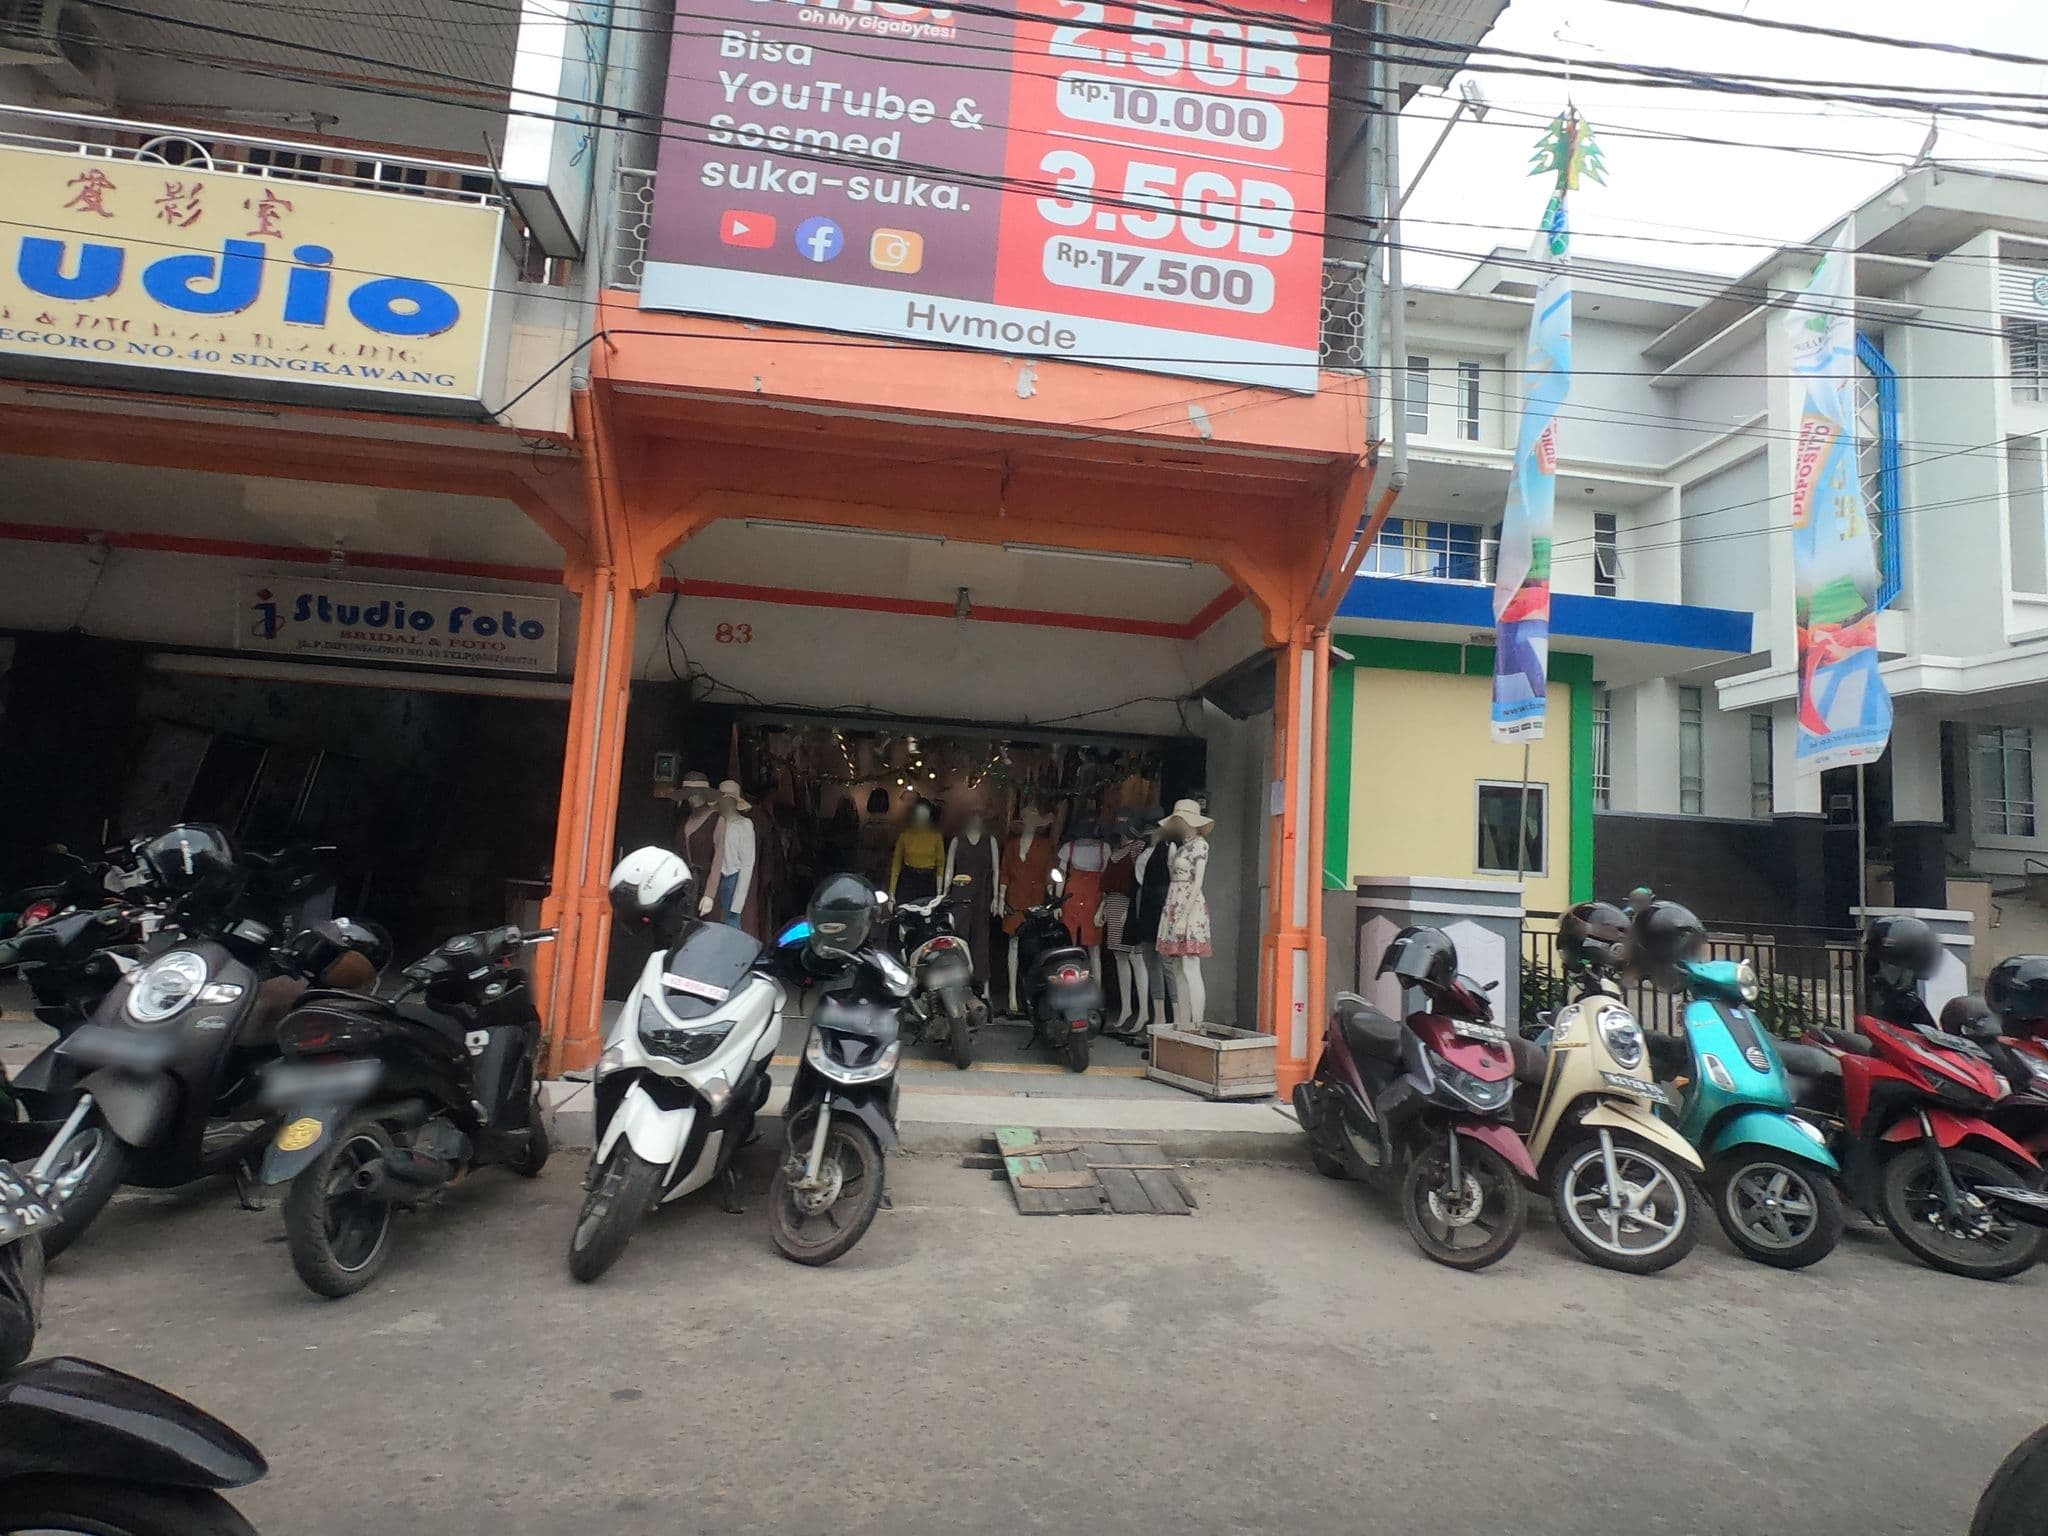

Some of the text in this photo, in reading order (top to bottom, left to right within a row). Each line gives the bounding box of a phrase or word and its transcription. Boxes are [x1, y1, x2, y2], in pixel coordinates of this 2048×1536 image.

[720, 29, 812, 65] Bisa
[798, 9, 824, 24] Oh
[828, 12, 853, 29] My
[859, 16, 956, 39] Gigabytes!
[1049, 0, 1299, 95] 2.5GB
[718, 70, 984, 131] YouTube &
[707, 114, 900, 160] Sosmed
[701, 160, 971, 211] suka-suka.
[1036, 150, 1294, 257] 3.5GB
[17, 236, 461, 337] udio
[907, 301, 1076, 349] Hvmode
[127, 341, 221, 363] NO.40
[230, 352, 456, 387] SINGKAWANG
[294, 593, 434, 632] Studio
[715, 622, 752, 644] 83
[341, 630, 424, 646] BRIDAL
[450, 639, 506, 650] FOTO
